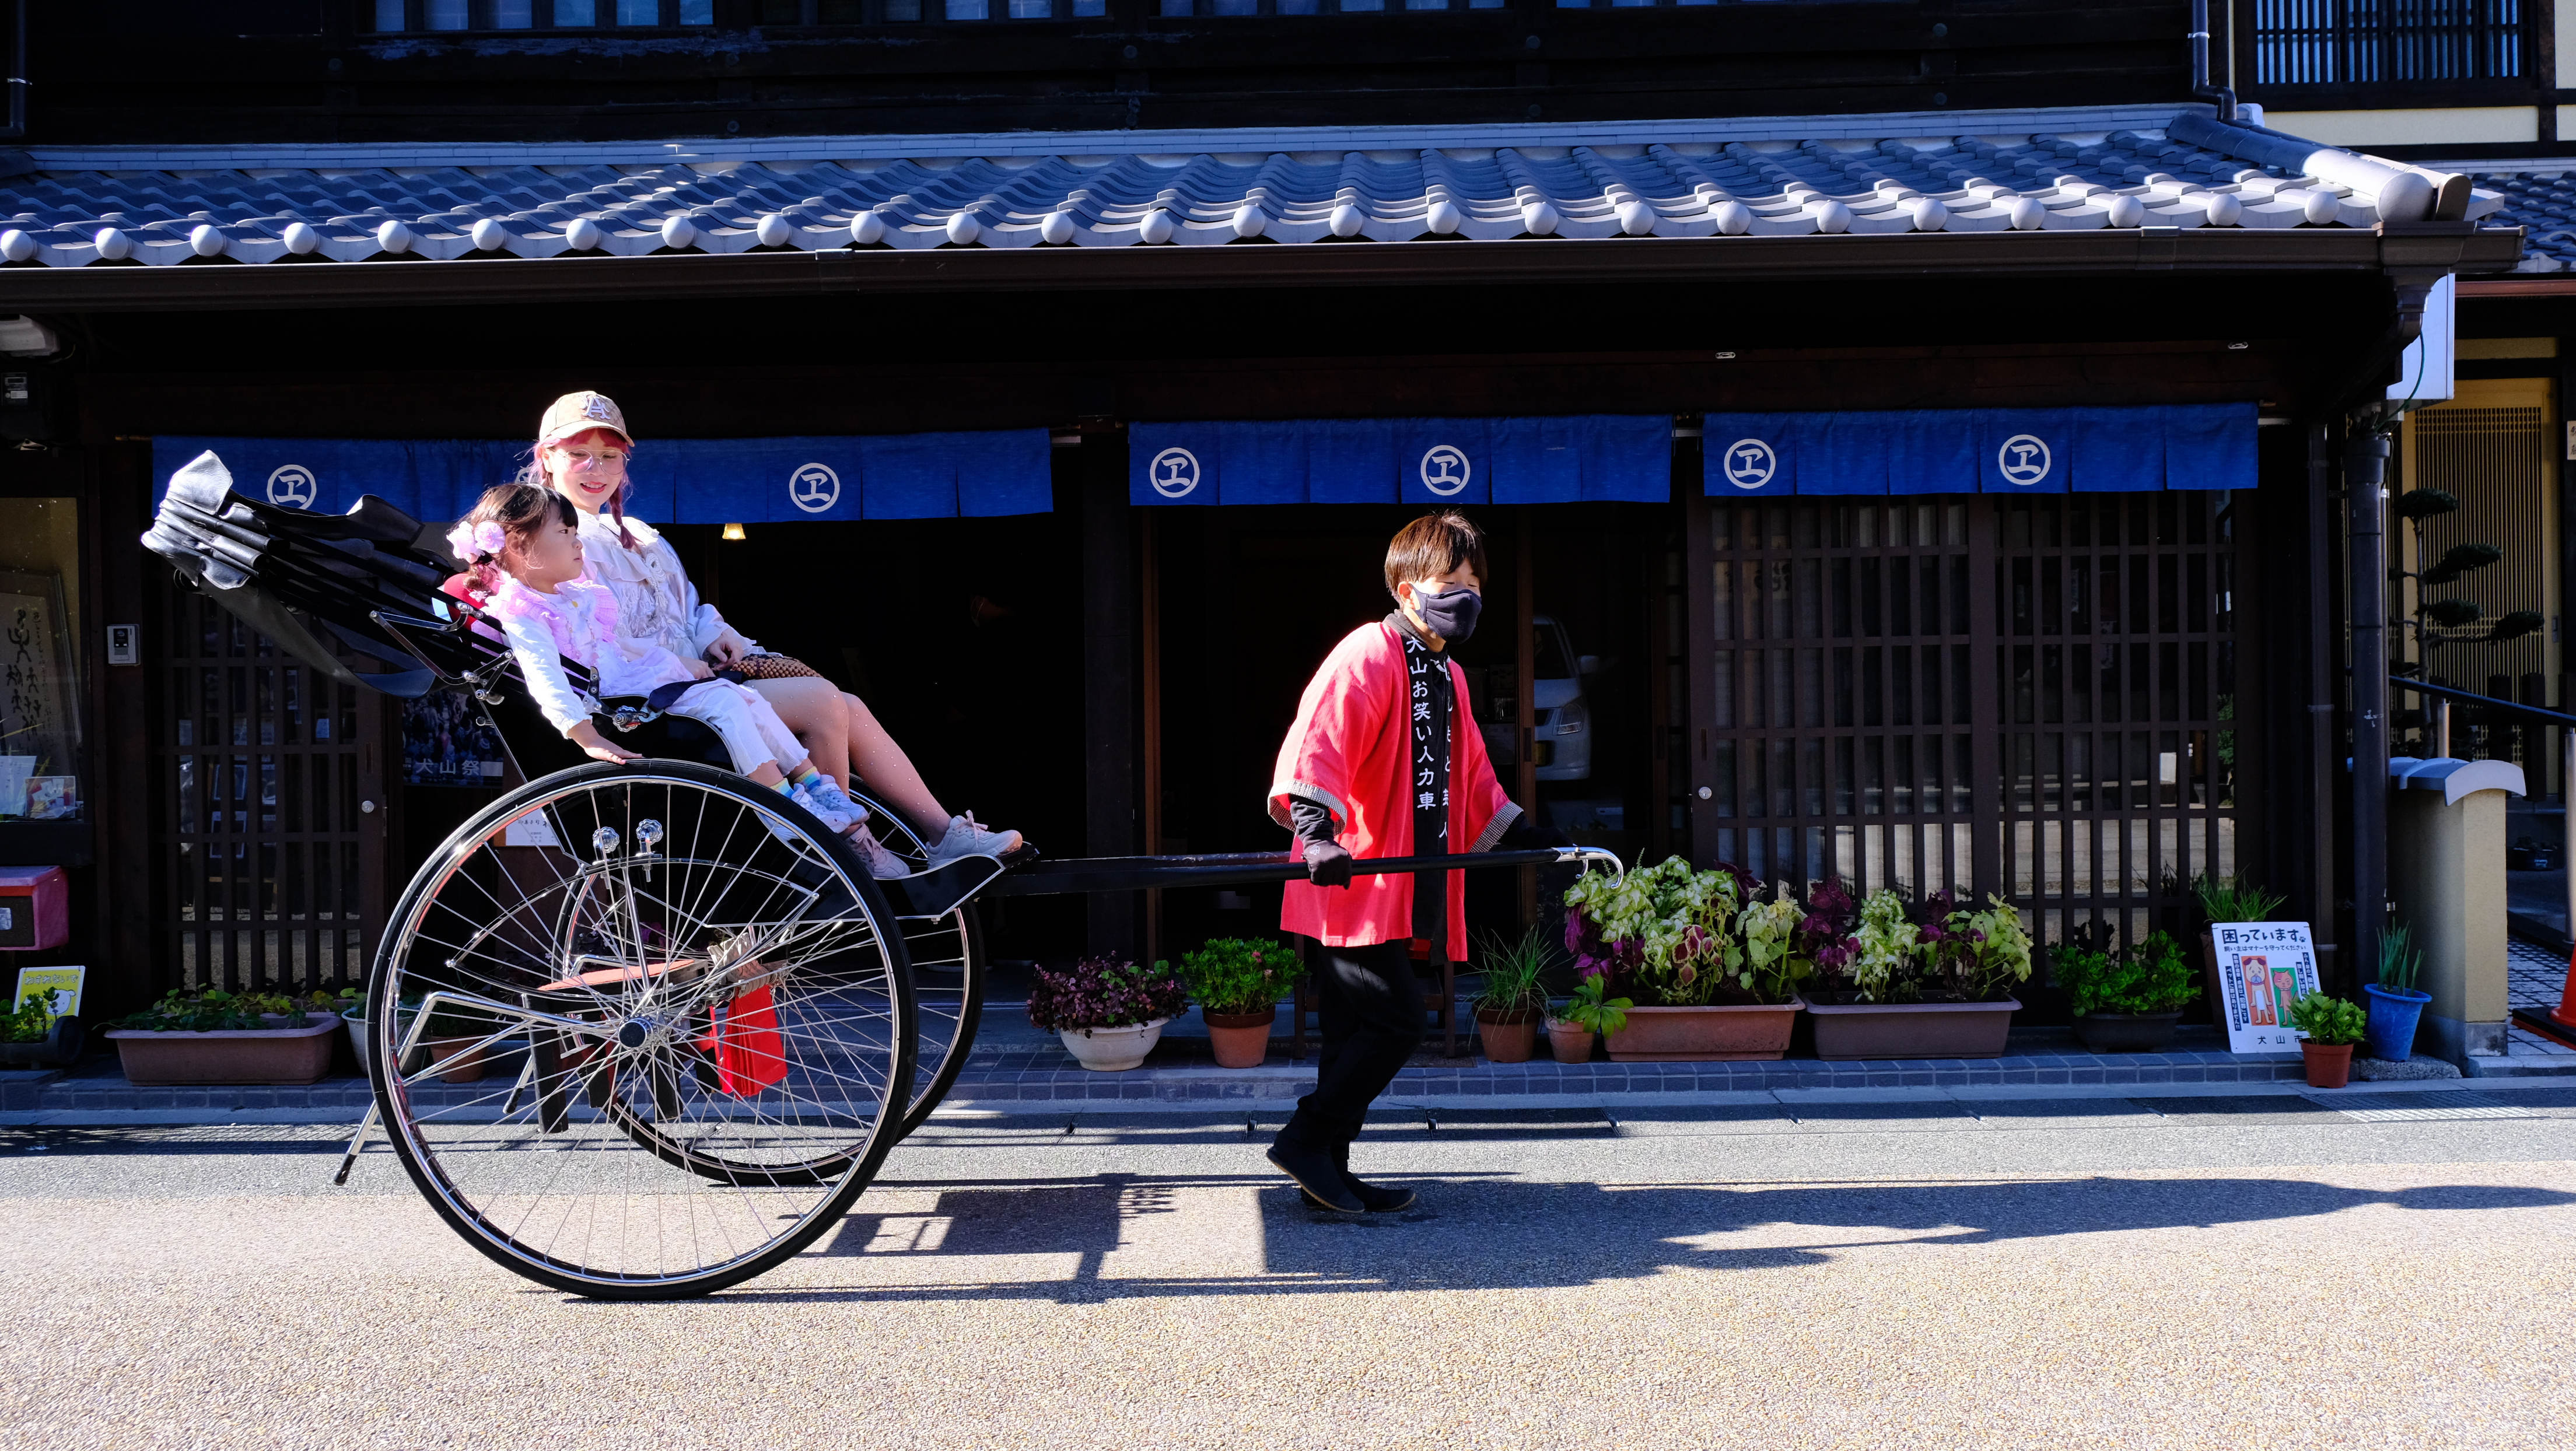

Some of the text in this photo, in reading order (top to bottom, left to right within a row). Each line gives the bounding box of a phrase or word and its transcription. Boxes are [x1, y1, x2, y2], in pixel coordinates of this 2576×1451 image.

[580, 394, 611, 420] A
[1406, 636, 1436, 811] 犬山お笑い人力車
[415, 758, 480, 776] 犬山祭
[24, 973, 79, 986] わすれないで
[2257, 1035, 2304, 1045] 犬山市
